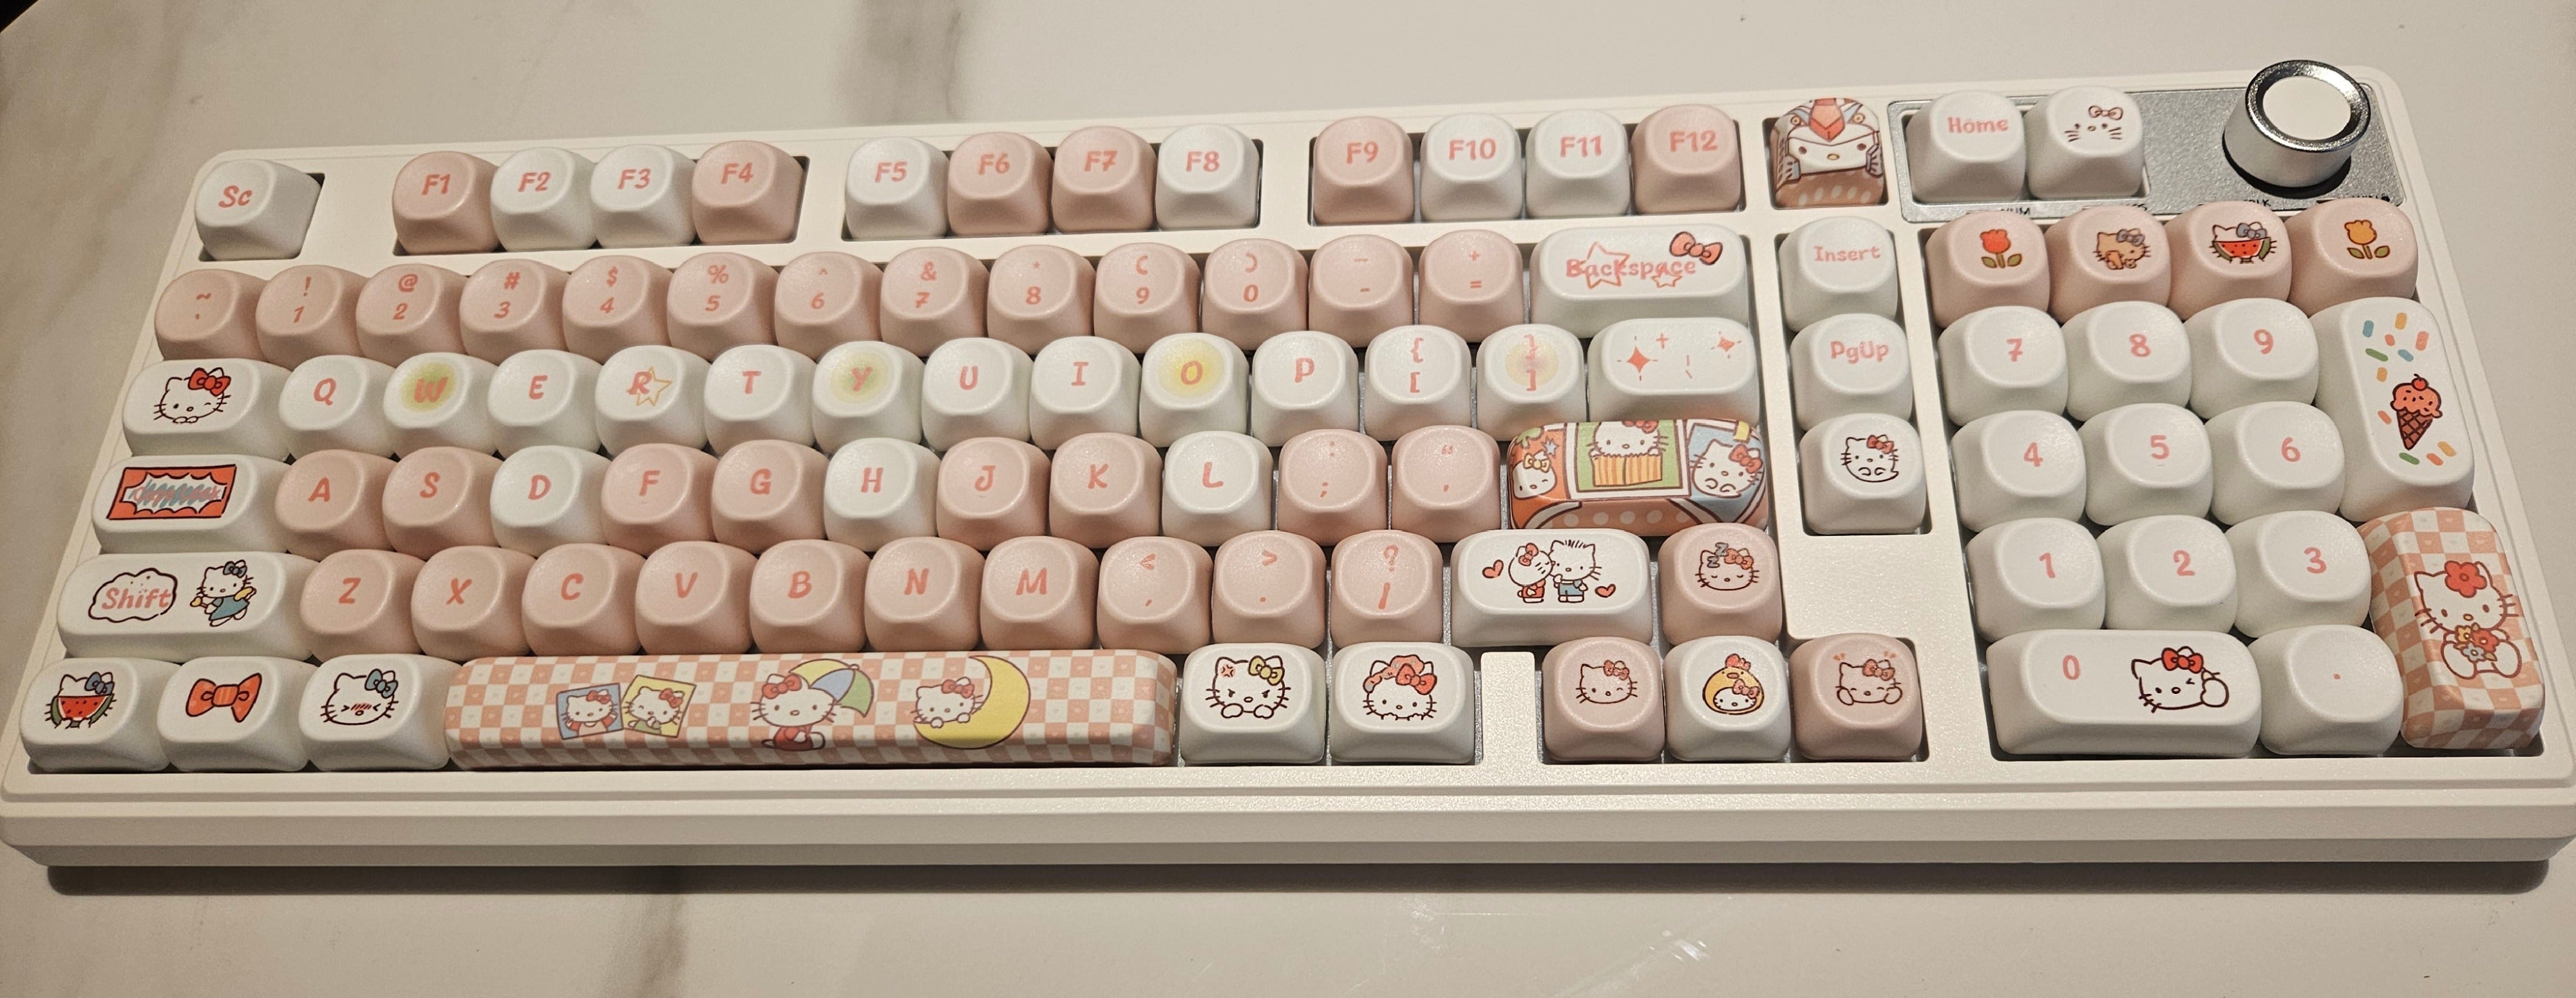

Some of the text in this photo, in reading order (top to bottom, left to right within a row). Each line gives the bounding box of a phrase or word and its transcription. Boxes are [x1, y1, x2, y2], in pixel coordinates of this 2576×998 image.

[1947, 117, 2009, 133] Home
[1448, 137, 1497, 160] F10
[1560, 135, 1603, 158] F11
[1669, 130, 1718, 152] F12
[978, 152, 1010, 175] F6
[1084, 149, 1117, 171] F7
[1186, 150, 1220, 172] F8
[1345, 141, 1379, 165] F9
[518, 171, 551, 192] F2
[618, 168, 651, 189] F3
[721, 162, 753, 184] F4
[874, 160, 907, 183] F5
[422, 173, 451, 195] F1
[218, 184, 253, 209] Sc
[1246, 252, 1258, 273] )
[1469, 250, 1480, 262] +
[1814, 245, 1881, 262] Insert
[606, 265, 618, 287] $
[707, 264, 730, 285] %
[817, 267, 829, 276] ^
[920, 261, 936, 282] &
[1135, 255, 1148, 276] (
[1566, 258, 1696, 280] Backspace
[303, 276, 312, 296] !
[397, 273, 419, 294] @
[504, 271, 520, 289] #
[1470, 280, 1482, 289] =
[705, 294, 720, 312] 5
[810, 291, 825, 309] 6
[915, 291, 930, 308] 7
[1025, 286, 1041, 305] 8
[1136, 286, 1151, 305] 9
[1242, 283, 1260, 303] 0
[294, 305, 305, 323] 1
[393, 302, 409, 321] 2
[494, 301, 511, 320] 3
[600, 297, 614, 314] 4
[1410, 336, 1425, 364] {
[1830, 340, 1889, 365] PgUp
[2007, 338, 2023, 362] 7
[2129, 334, 2151, 358] 8
[2253, 329, 2274, 356] 9
[851, 366, 873, 392] Y
[958, 366, 979, 391] U
[1071, 361, 1088, 387] I
[1180, 360, 1203, 386] O
[1294, 357, 1316, 383] P
[1526, 369, 1537, 391] ]
[313, 378, 337, 407] Q
[413, 377, 448, 403] W
[529, 374, 548, 400] E
[628, 371, 652, 395] R
[742, 370, 761, 394] T
[1410, 371, 1421, 394] [
[2023, 442, 2043, 468] 4
[2149, 434, 2170, 461] 5
[2280, 437, 2302, 463] 6
[419, 471, 440, 499] S
[639, 469, 660, 495] F
[750, 468, 772, 495] G
[860, 466, 884, 494] H
[974, 465, 996, 492] J
[1088, 464, 1108, 490] K
[1202, 462, 1224, 488] L
[308, 477, 331, 503] A
[528, 474, 551, 501] D
[1320, 481, 1329, 499] ;
[1140, 553, 1156, 570] <
[1262, 550, 1278, 566] >
[1383, 544, 1400, 573] ?
[2039, 552, 2056, 579] 1
[2172, 550, 2194, 577] 2
[2304, 547, 2327, 574] 3
[338, 577, 361, 605] Z
[447, 578, 472, 605] X
[560, 572, 584, 601] C
[676, 572, 698, 599] V
[788, 570, 812, 600] B
[904, 568, 929, 595] N
[1016, 568, 1048, 596] M
[101, 587, 172, 609] Shift
[2062, 655, 2081, 680] 0
